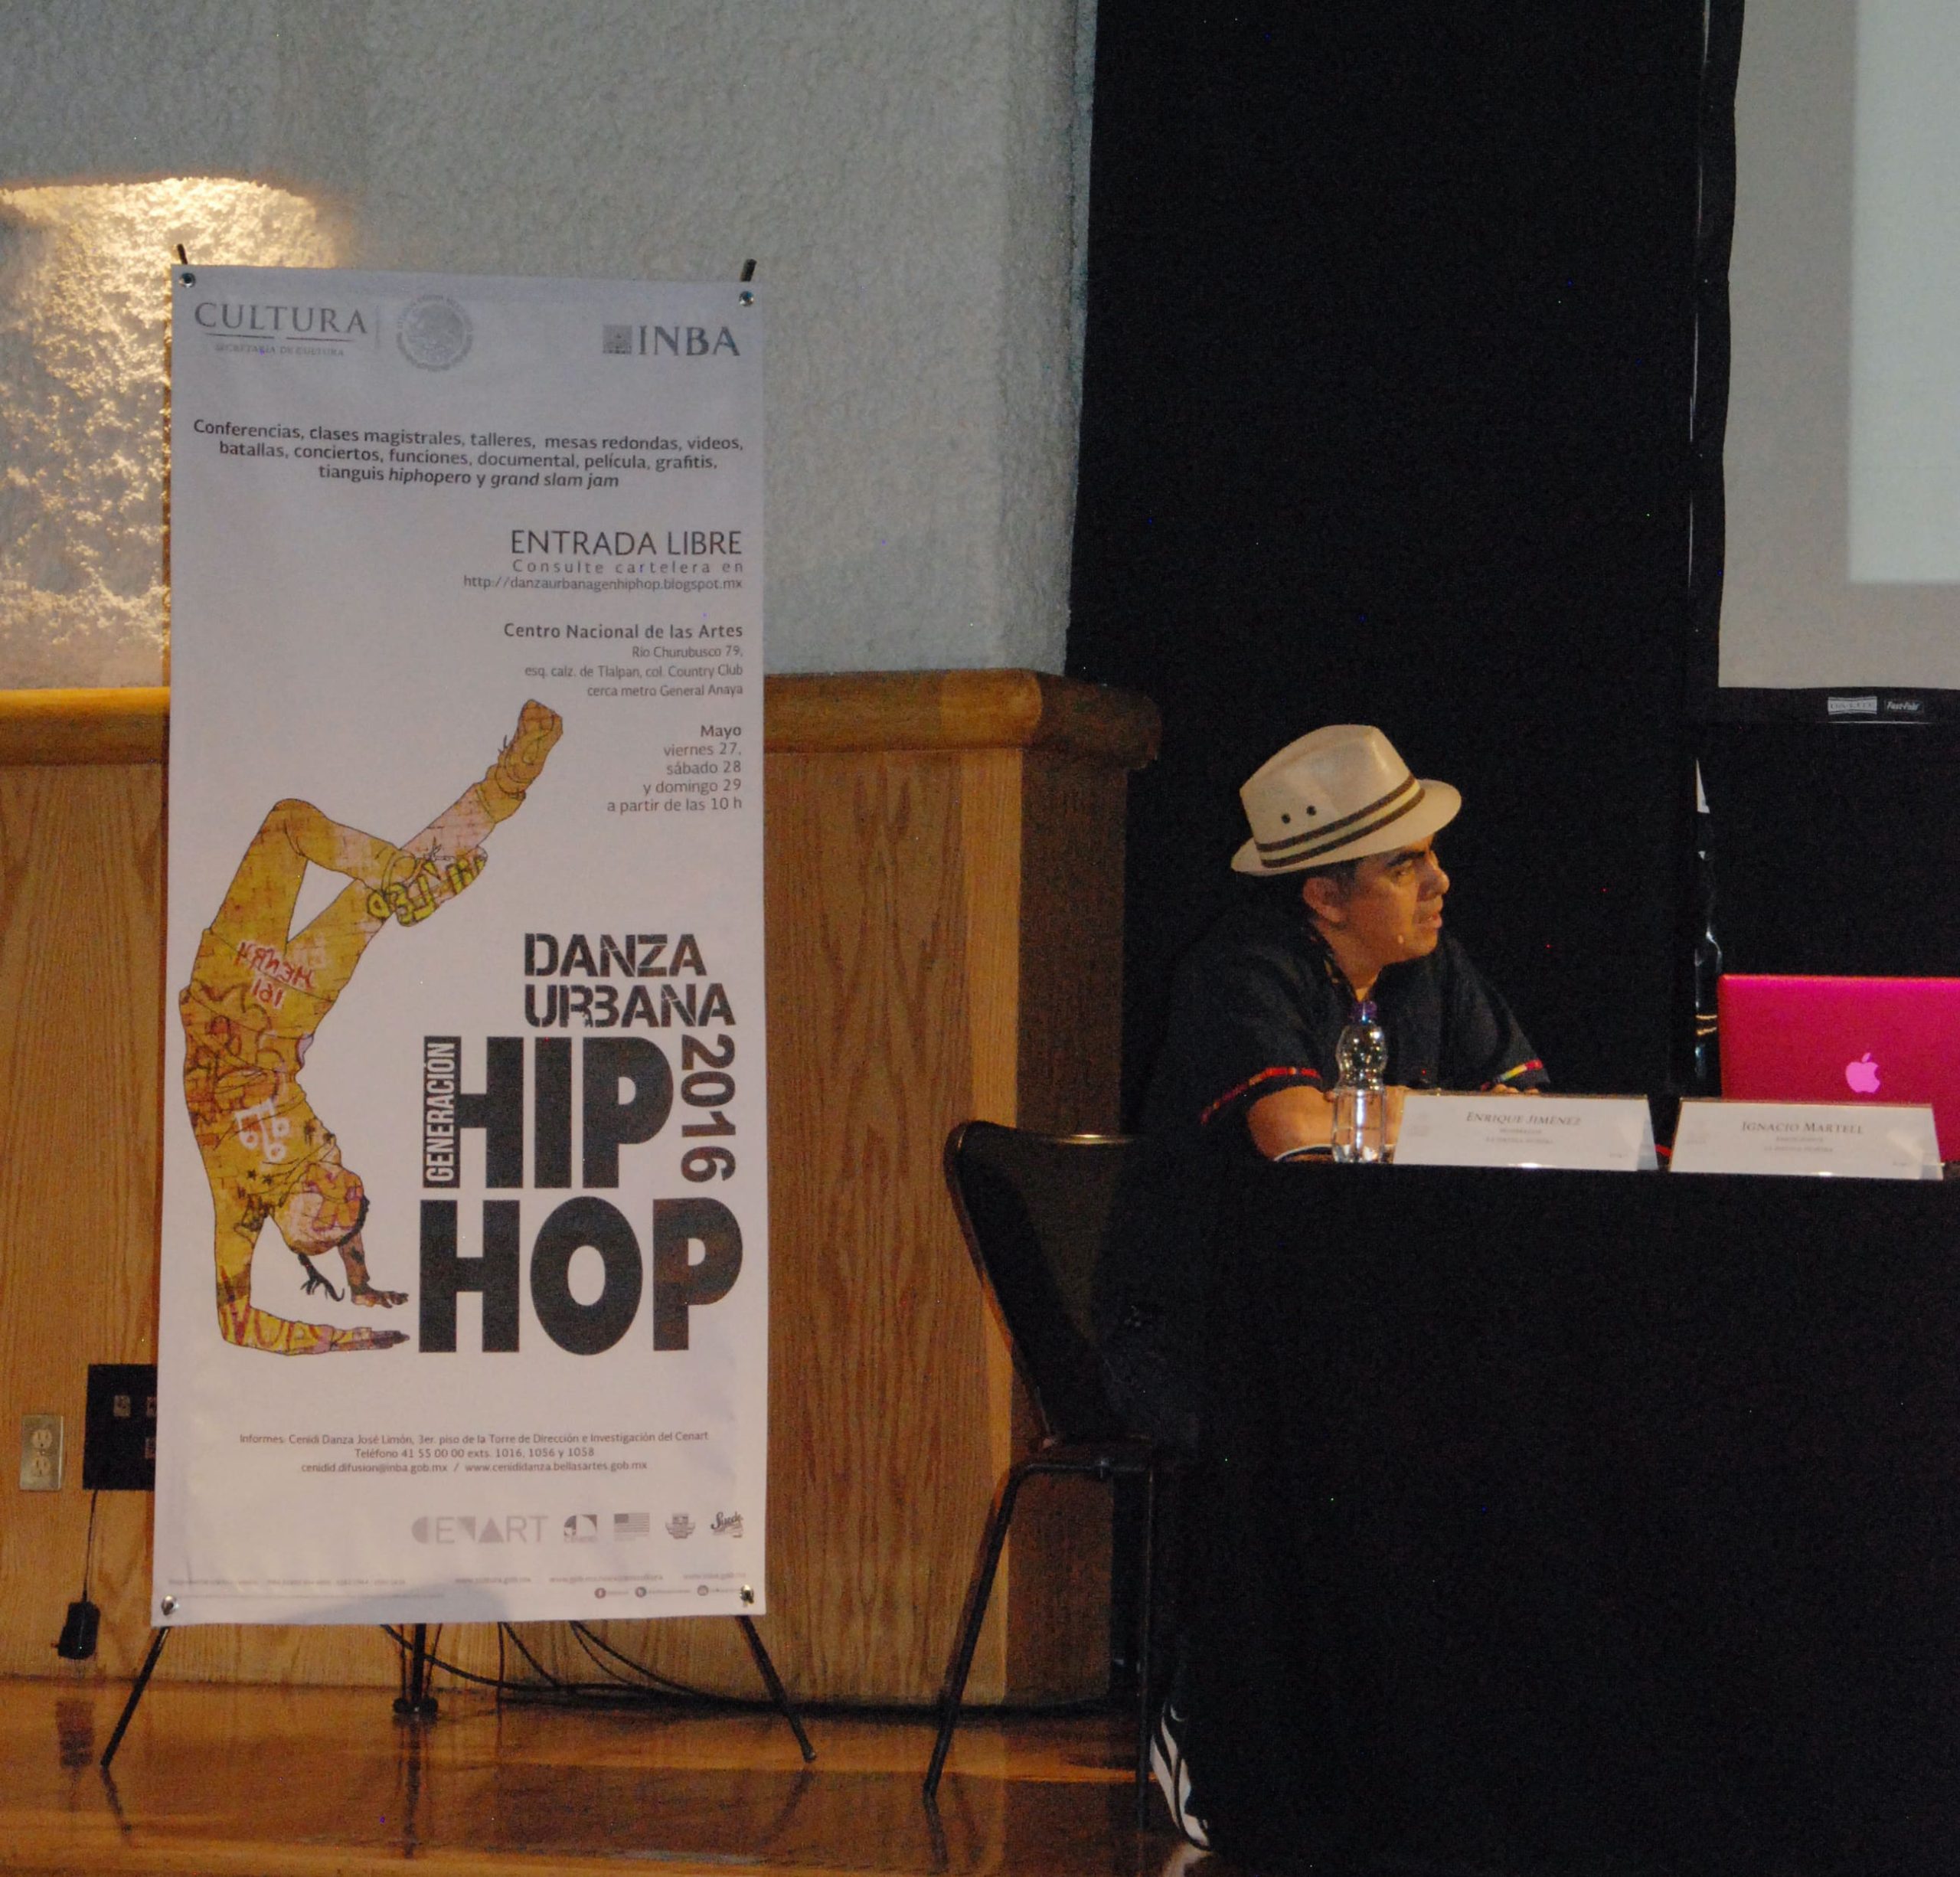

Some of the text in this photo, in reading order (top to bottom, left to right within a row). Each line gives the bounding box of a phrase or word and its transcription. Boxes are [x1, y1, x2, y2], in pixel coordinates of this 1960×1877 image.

[194, 302, 368, 335] CULTURA
[639, 325, 740, 357] INBA
[193, 418, 744, 451] Conferencias, clases magistrales, talleres, mesas redondas, videos,
[219, 440, 289, 459] batallas,
[294, 445, 384, 463] conciertos,
[389, 447, 474, 466] funciones,
[477, 451, 579, 469] documental,
[584, 453, 651, 472] película,
[318, 464, 619, 491] tianguis hiphopero y grand slam jam
[511, 528, 743, 556] ENTRADA LIBRE
[512, 558, 743, 574] Consulte cartelera en
[503, 622, 743, 639] Centro Nacional de las Artes
[652, 645, 722, 659] Churubusco
[580, 664, 594, 678] de
[596, 665, 642, 680] Tlalpan,
[668, 665, 715, 681] Country
[717, 663, 743, 676] Club
[586, 683, 743, 698] cerca metro General Anaya
[700, 724, 742, 739] Mayo
[663, 743, 714, 757] viernes
[665, 760, 742, 776] sábado 28
[642, 779, 742, 796] y domingo 29
[606, 796, 742, 814] a partir de las 10 h
[524, 933, 708, 978] DANZA
[524, 983, 737, 1028] URBANA
[422, 1035, 674, 1189] HIP
[426, 1042, 455, 1182] GENERACIÓN
[680, 1033, 737, 1184] 2016
[1465, 1111, 1524, 1125] ENRIQUE
[1742, 1121, 1863, 1135] IGNACIO MARTELL
[419, 1195, 743, 1356] HOP
[289, 1434, 320, 1445] Cenidi
[322, 1434, 354, 1445] Danza
[357, 1434, 380, 1445] José
[381, 1434, 415, 1446] Limón,
[439, 1434, 459, 1446] piso
[462, 1434, 475, 1445] de
[476, 1434, 487, 1444] la
[488, 1434, 516, 1444] Torre
[518, 1434, 531, 1444] de
[533, 1433, 580, 1444] Dirección
[581, 1434, 588, 1444] e
[590, 1432, 656, 1445] Investigación
[658, 1432, 673, 1442] del
[675, 1431, 709, 1441] Cenart
[354, 1448, 398, 1459] Teléfono
[400, 1448, 414, 1459] 41
[419, 1448, 432, 1459] 55
[434, 1448, 449, 1459] 00
[450, 1448, 466, 1459] 00
[495, 1447, 525, 1459] 1016,
[528, 1447, 555, 1458] 1056
[557, 1449, 564, 1459] y
[568, 1447, 595, 1457] 1058
[452, 1463, 459, 1473] /
